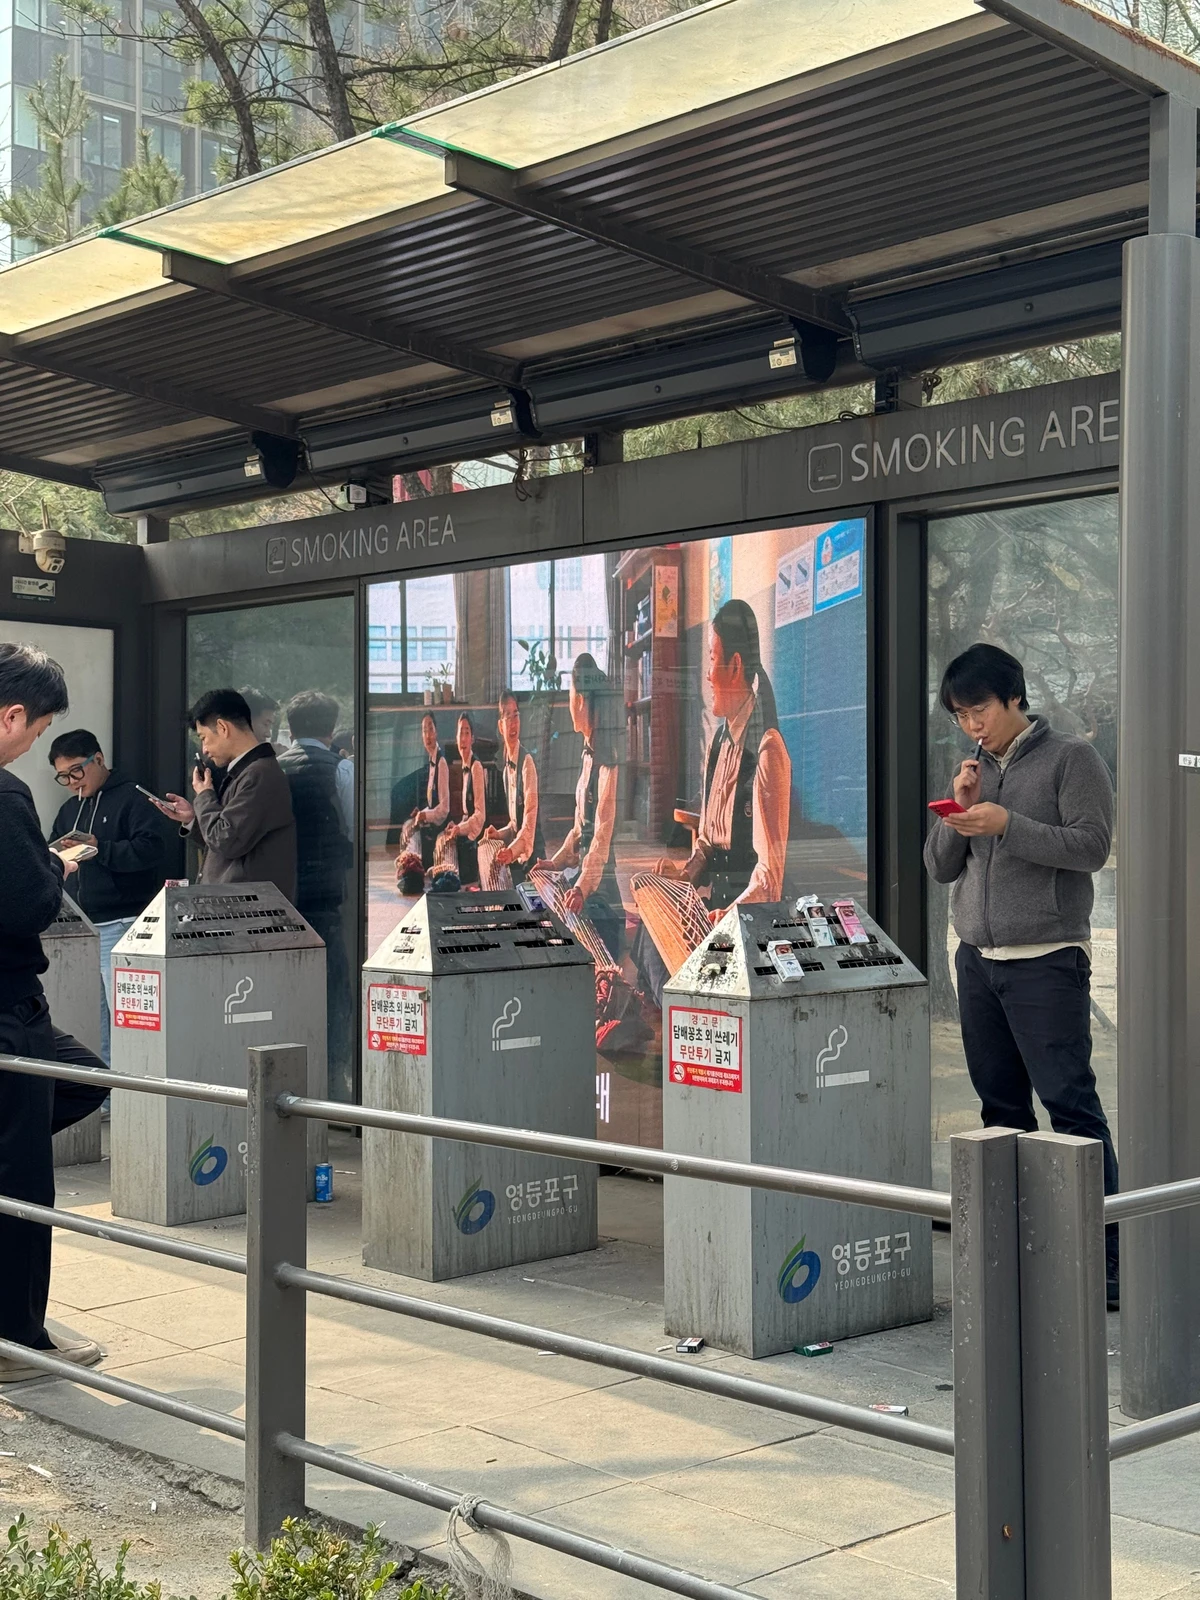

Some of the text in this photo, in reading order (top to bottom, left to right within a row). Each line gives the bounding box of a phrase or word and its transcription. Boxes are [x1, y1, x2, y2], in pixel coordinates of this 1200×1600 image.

[851, 399, 1119, 483] SMOKING ARE
[291, 514, 456, 567] SMOKING AREA
[117, 982, 158, 997] 담배꽁초 외 쓰레기
[121, 996, 154, 1011] 무단투기 금지
[371, 999, 423, 1017] 담배꽁초 외 쓰레기
[376, 1016, 418, 1033] 무단투기 금지
[673, 1025, 738, 1048] 담배꽁초 외 쓰레기
[680, 1044, 731, 1066] 무단투기 금지
[505, 1174, 579, 1212] 영등포구
[507, 1204, 578, 1225] YEONGDEUNGPO-GU
[831, 1231, 912, 1276] 영등포구
[834, 1267, 911, 1292] YEONGDEUNGPO-GU
